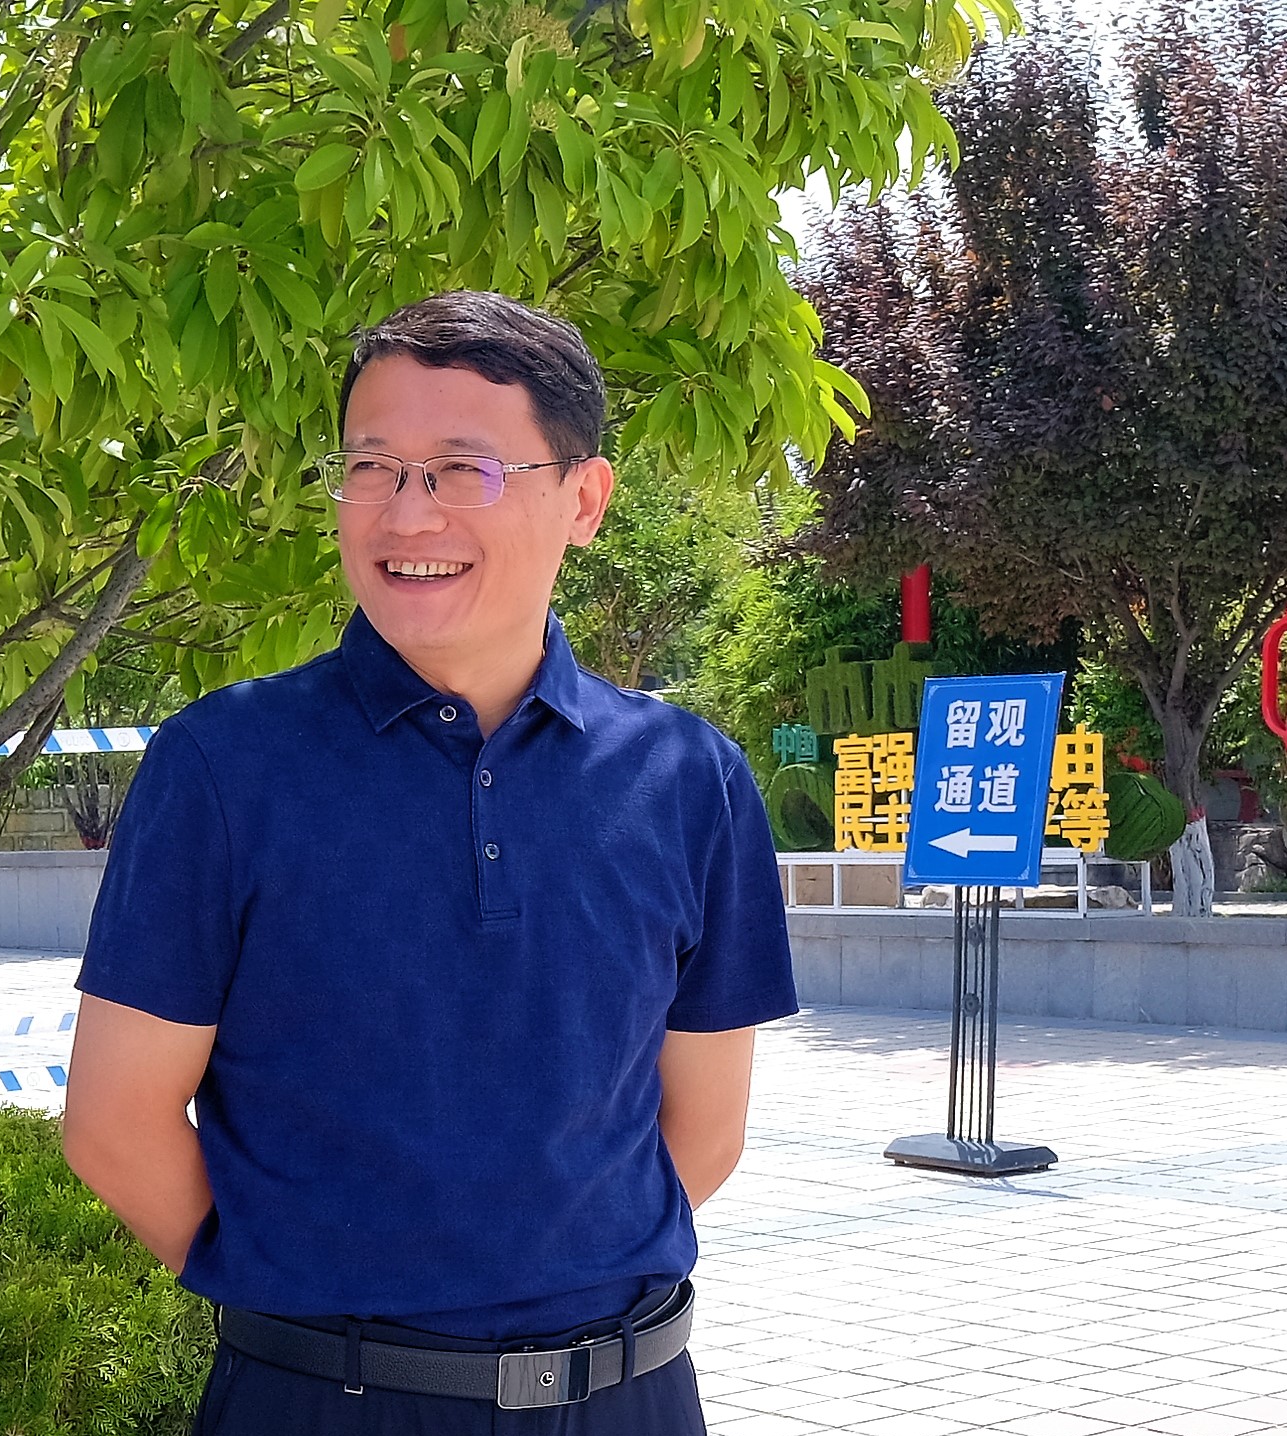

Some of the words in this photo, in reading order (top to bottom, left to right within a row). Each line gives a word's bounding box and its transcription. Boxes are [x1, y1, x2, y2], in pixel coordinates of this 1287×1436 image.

[946, 699, 1027, 748] 留观
[833, 732, 915, 795] 富强
[934, 763, 1020, 812] 通道
[834, 795, 912, 851] 民主
